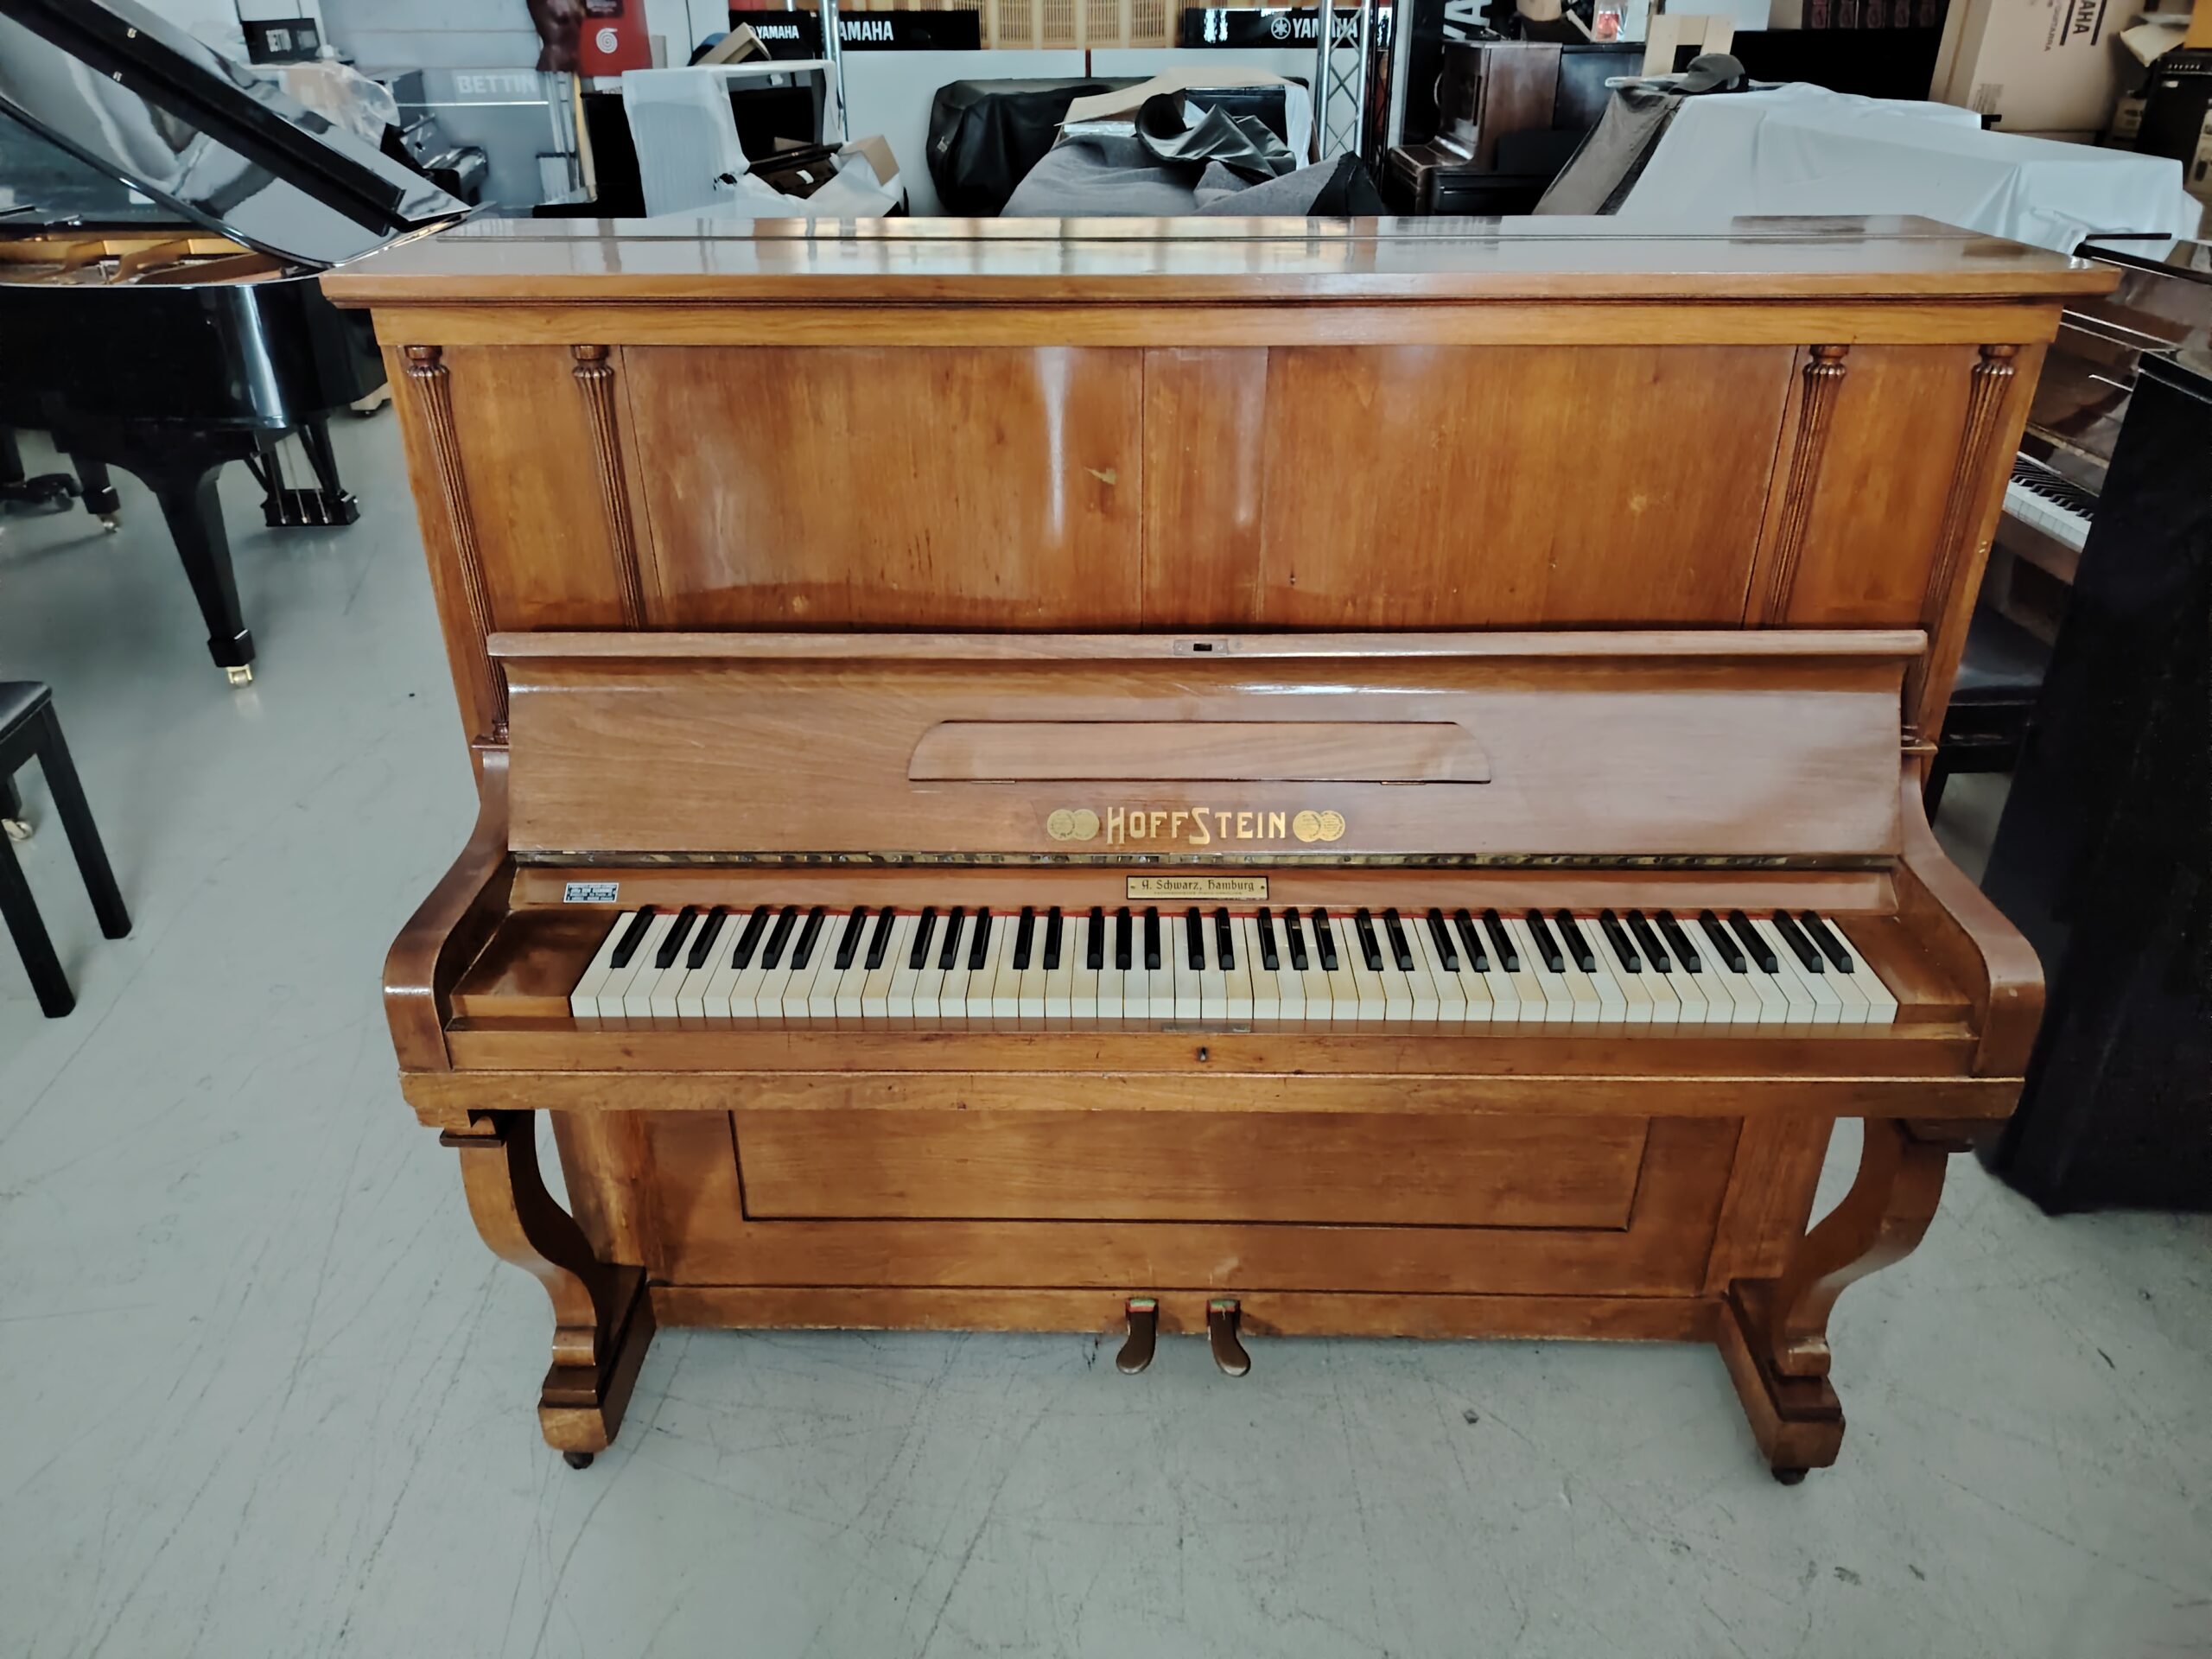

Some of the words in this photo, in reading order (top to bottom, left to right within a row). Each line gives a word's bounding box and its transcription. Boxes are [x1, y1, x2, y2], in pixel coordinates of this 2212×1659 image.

[2073, 0, 2095, 34] AHA
[756, 25, 799, 39] YAMAHA
[839, 21, 893, 41] AMAHA
[1208, 880, 1255, 892] Hamburg
